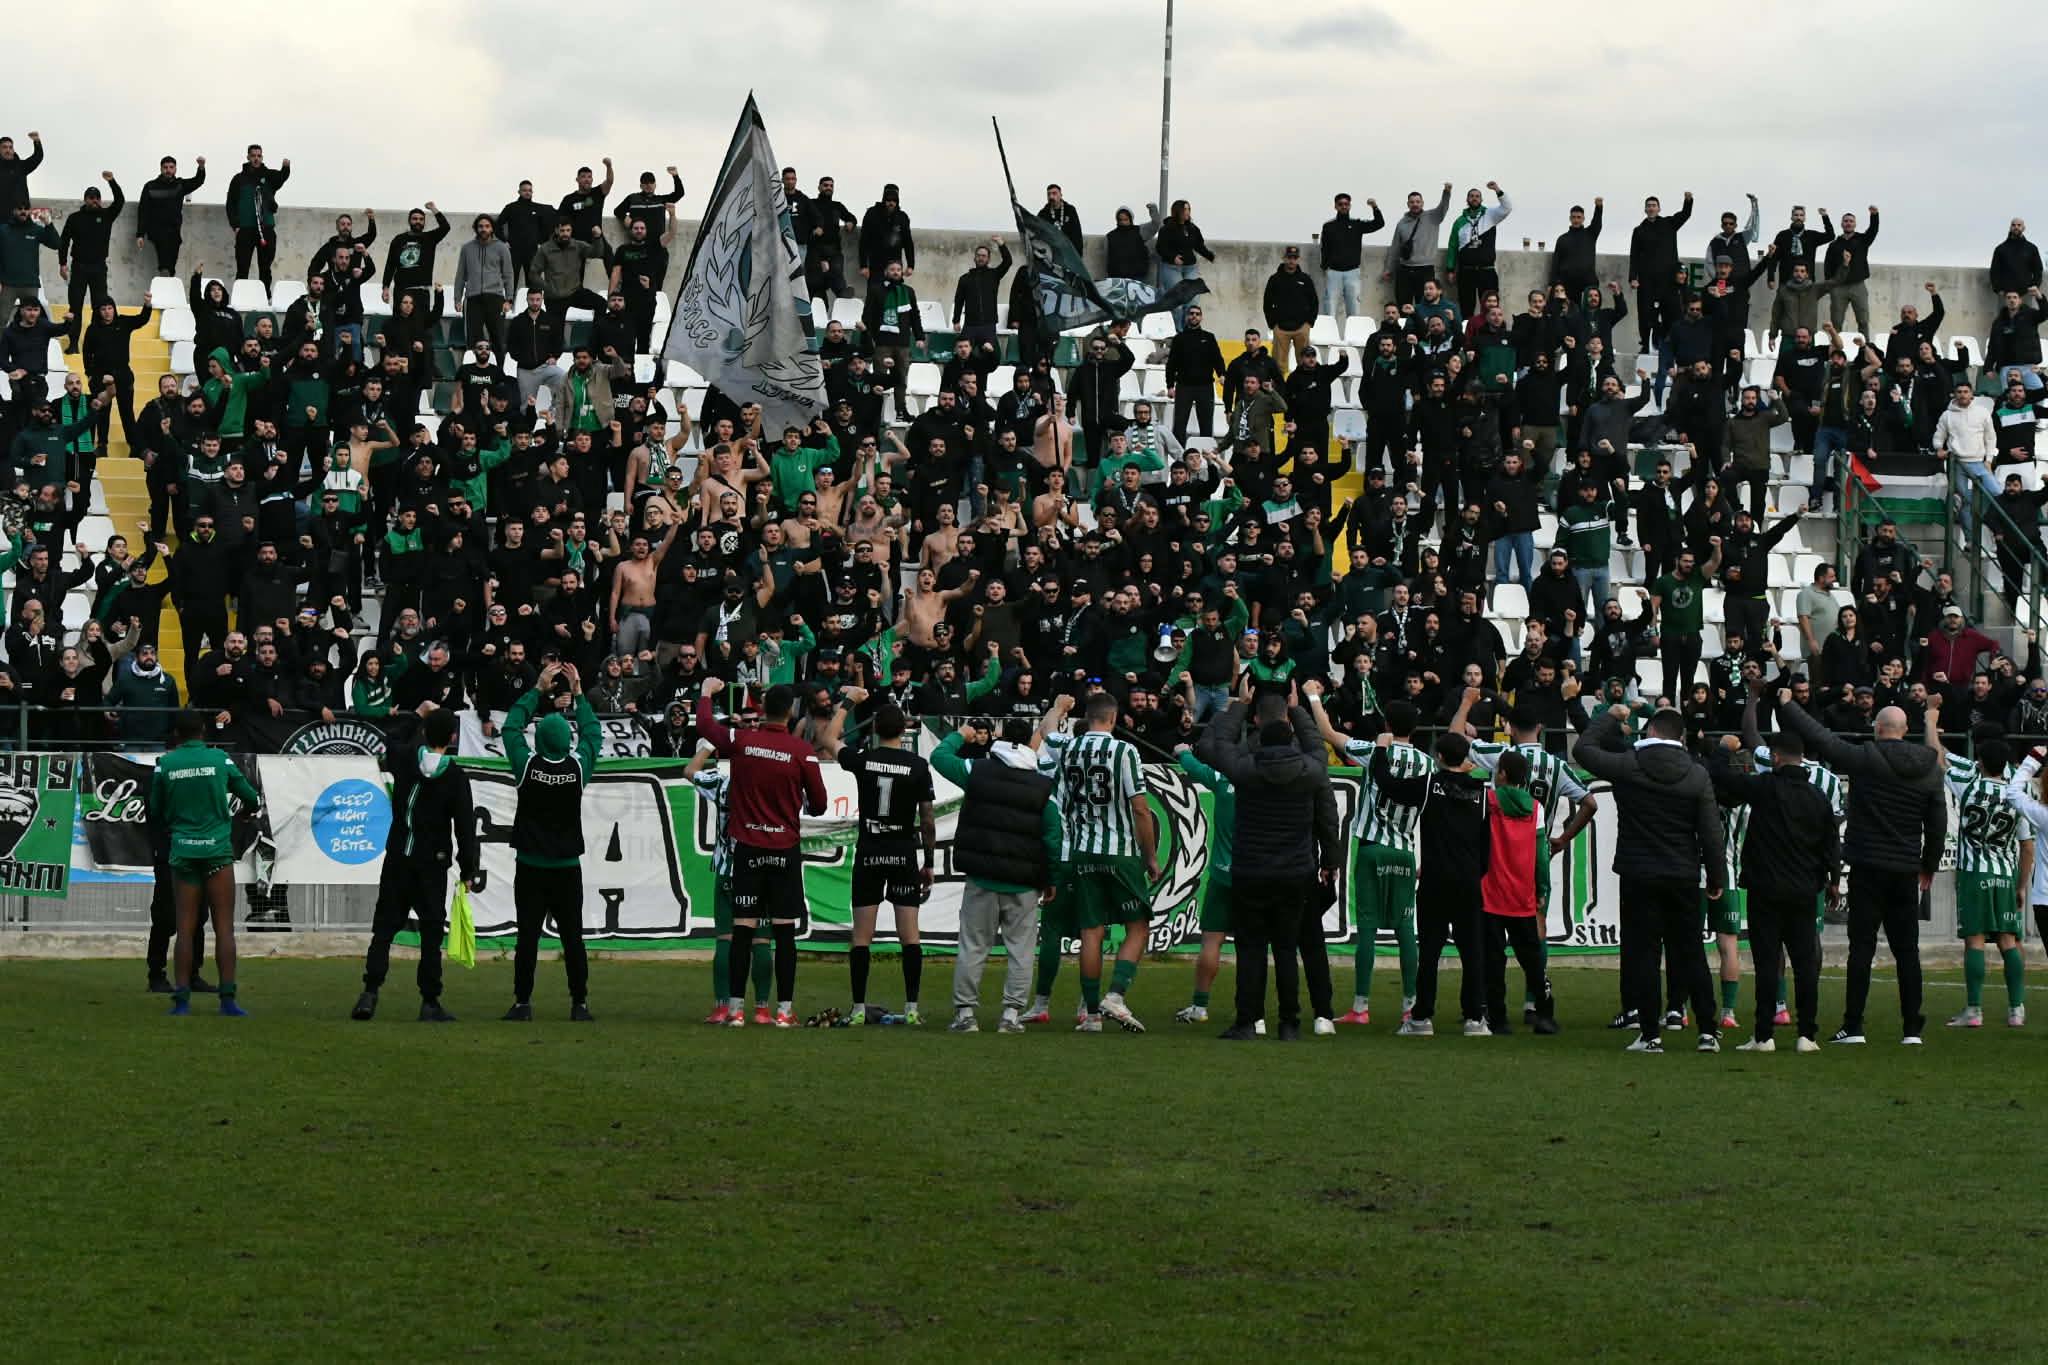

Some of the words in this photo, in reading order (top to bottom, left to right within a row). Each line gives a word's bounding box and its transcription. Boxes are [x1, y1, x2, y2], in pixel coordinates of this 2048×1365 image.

[530, 769, 577, 785] Kappa
[1066, 764, 1113, 807] 23
[877, 775, 894, 817] 1
[340, 824, 365, 836] LIVE
[1963, 803, 2016, 849] 22
[330, 838, 377, 852] BETTER
[735, 895, 758, 905] one
